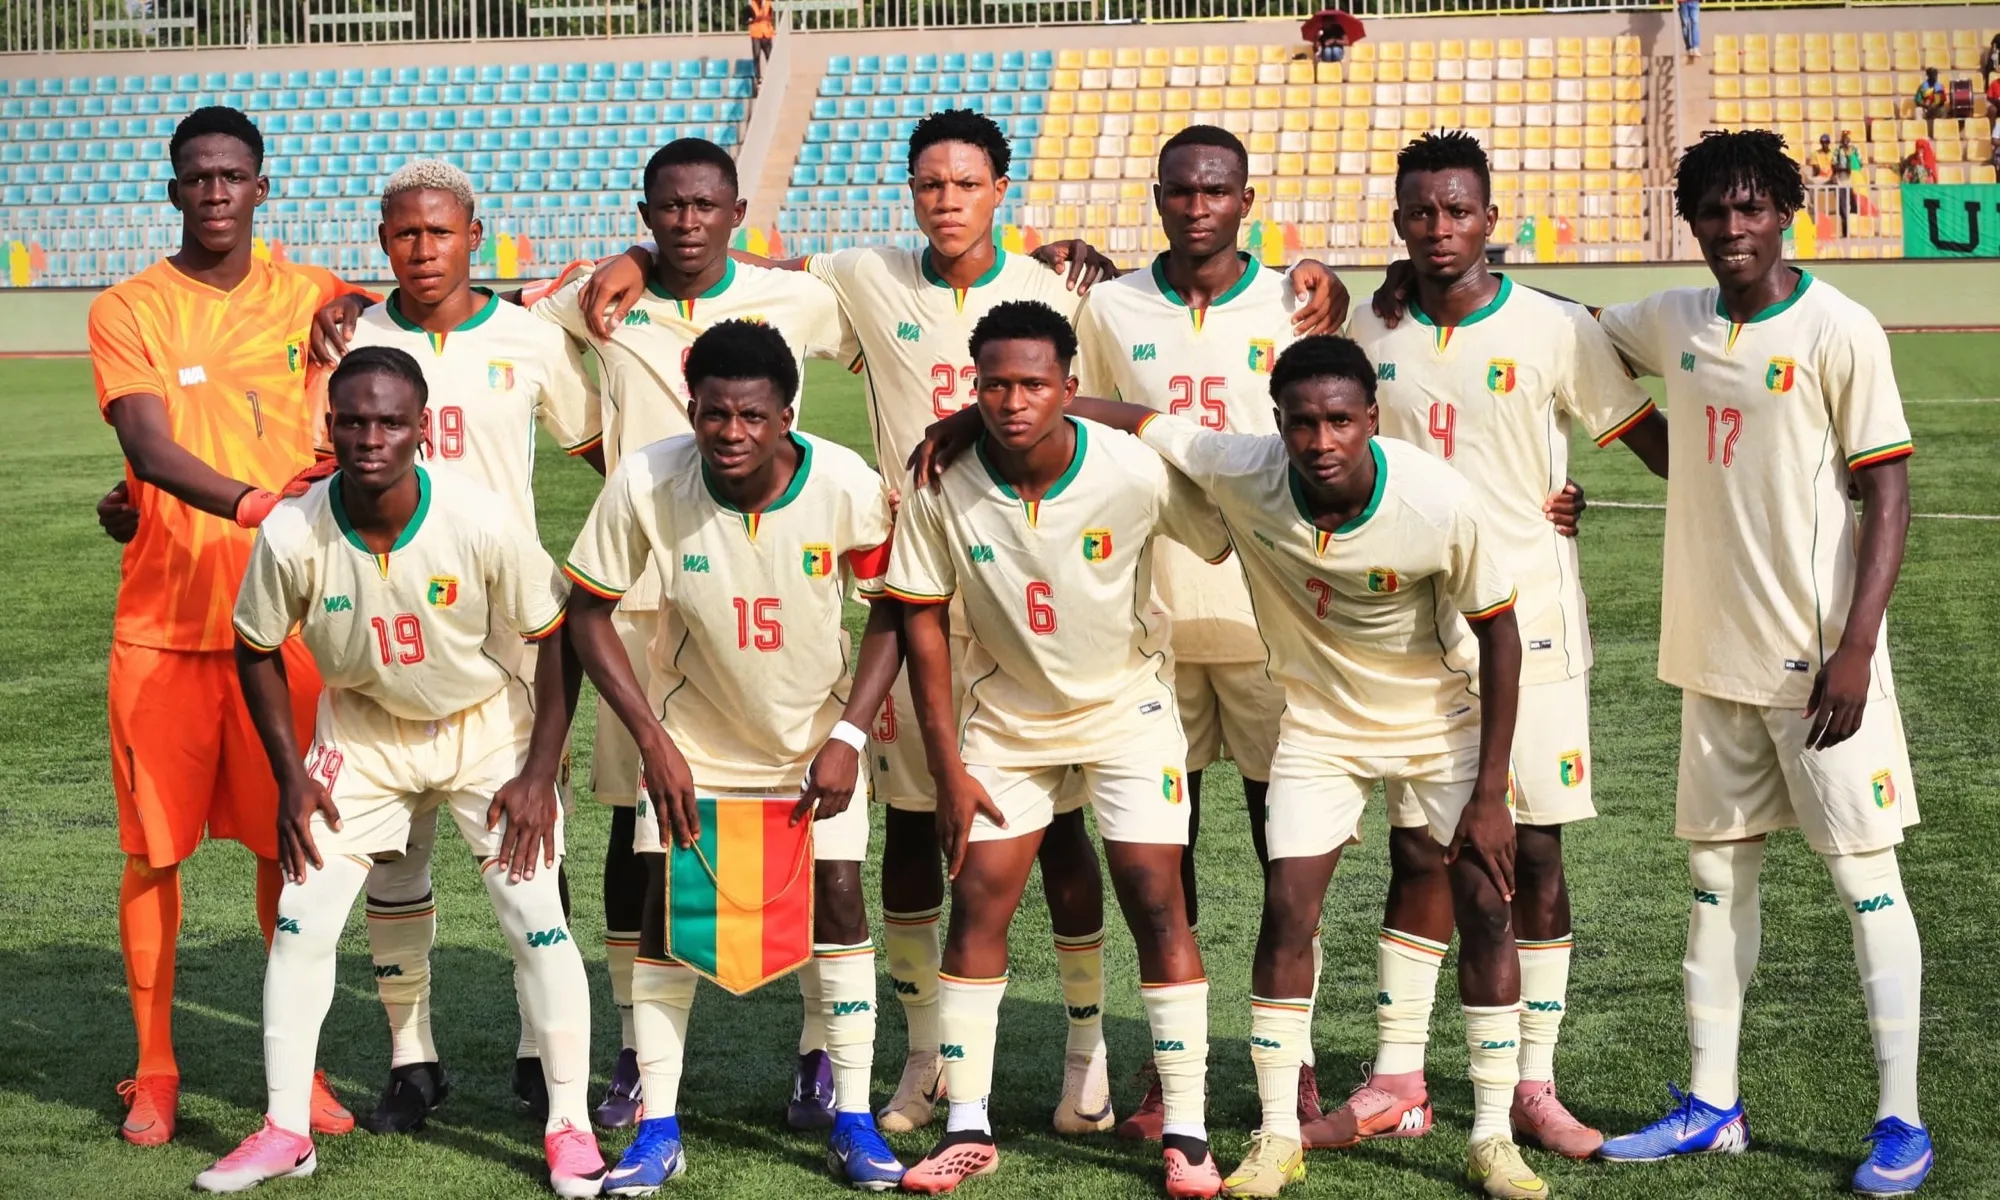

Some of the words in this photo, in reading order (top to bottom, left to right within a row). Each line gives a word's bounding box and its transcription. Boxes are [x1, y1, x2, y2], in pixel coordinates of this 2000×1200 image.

[1923, 199, 2000, 253] U
[897, 321, 920, 343] WA
[1132, 343, 1156, 361] WA
[1377, 363, 1396, 381] WA
[1169, 375, 1228, 432] 25
[246, 391, 263, 440] 1
[1429, 402, 1456, 461] 4
[1706, 405, 1742, 468] 17
[683, 554, 709, 573] WA
[968, 545, 995, 563] WA
[323, 595, 352, 613] WA
[1026, 582, 1057, 635] 6
[1306, 577, 1331, 620] 7
[733, 597, 783, 652] 15
[371, 613, 425, 666] 19
[872, 692, 897, 743] 3
[1854, 893, 1894, 913] WA
[526, 926, 568, 947] WA
[375, 964, 403, 978] WA
[833, 1001, 870, 1015] WA
[1068, 1004, 1099, 1019] WA
[1155, 1040, 1185, 1051] WA
